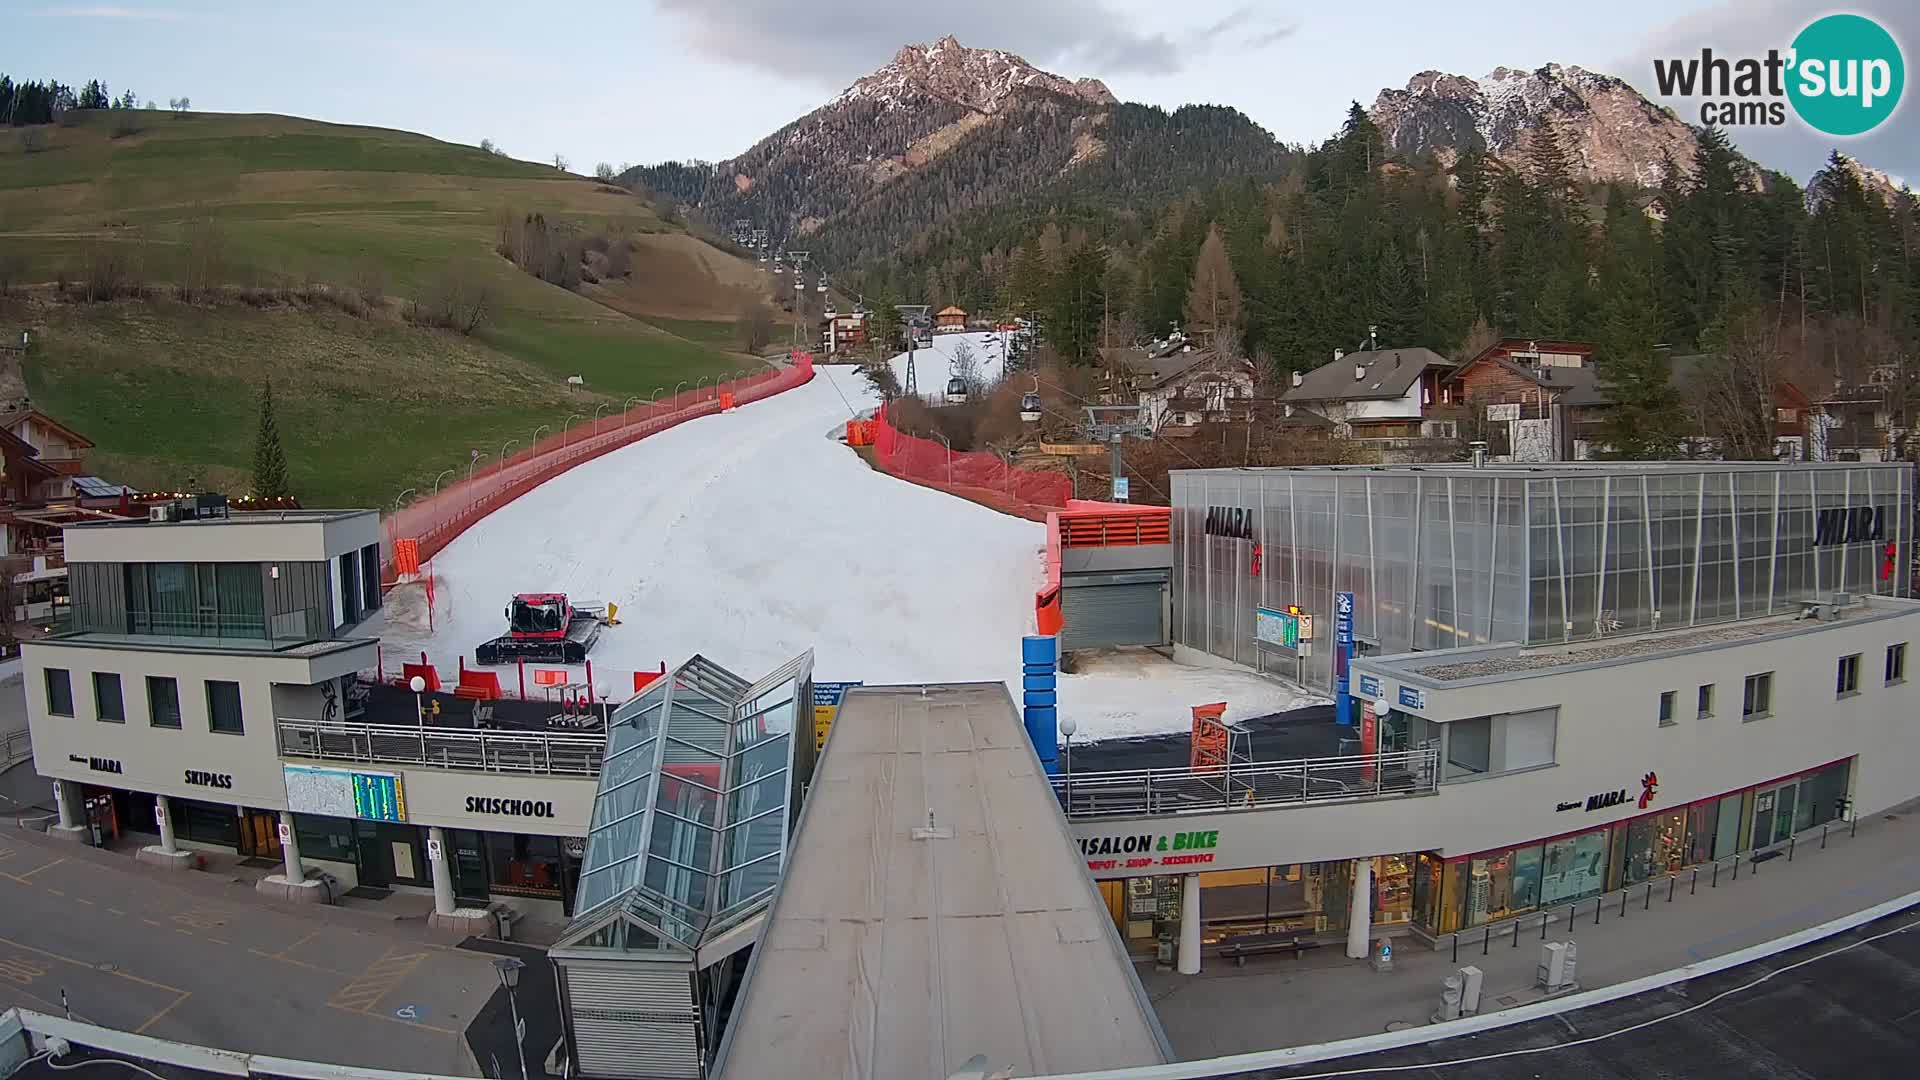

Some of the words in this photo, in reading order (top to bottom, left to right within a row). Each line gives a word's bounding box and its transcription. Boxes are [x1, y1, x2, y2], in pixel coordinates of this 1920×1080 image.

[1205, 505, 1254, 540] MIARA
[1813, 506, 1886, 546] MIARA
[89, 756, 123, 775] MIARA
[184, 769, 233, 790] SKIPASS
[465, 795, 555, 818] SKISCHOOL
[1584, 789, 1626, 812] MIARA
[1156, 836, 1169, 852] &
[1172, 830, 1220, 851] BIKE
[1125, 858, 1153, 868] SHOP
